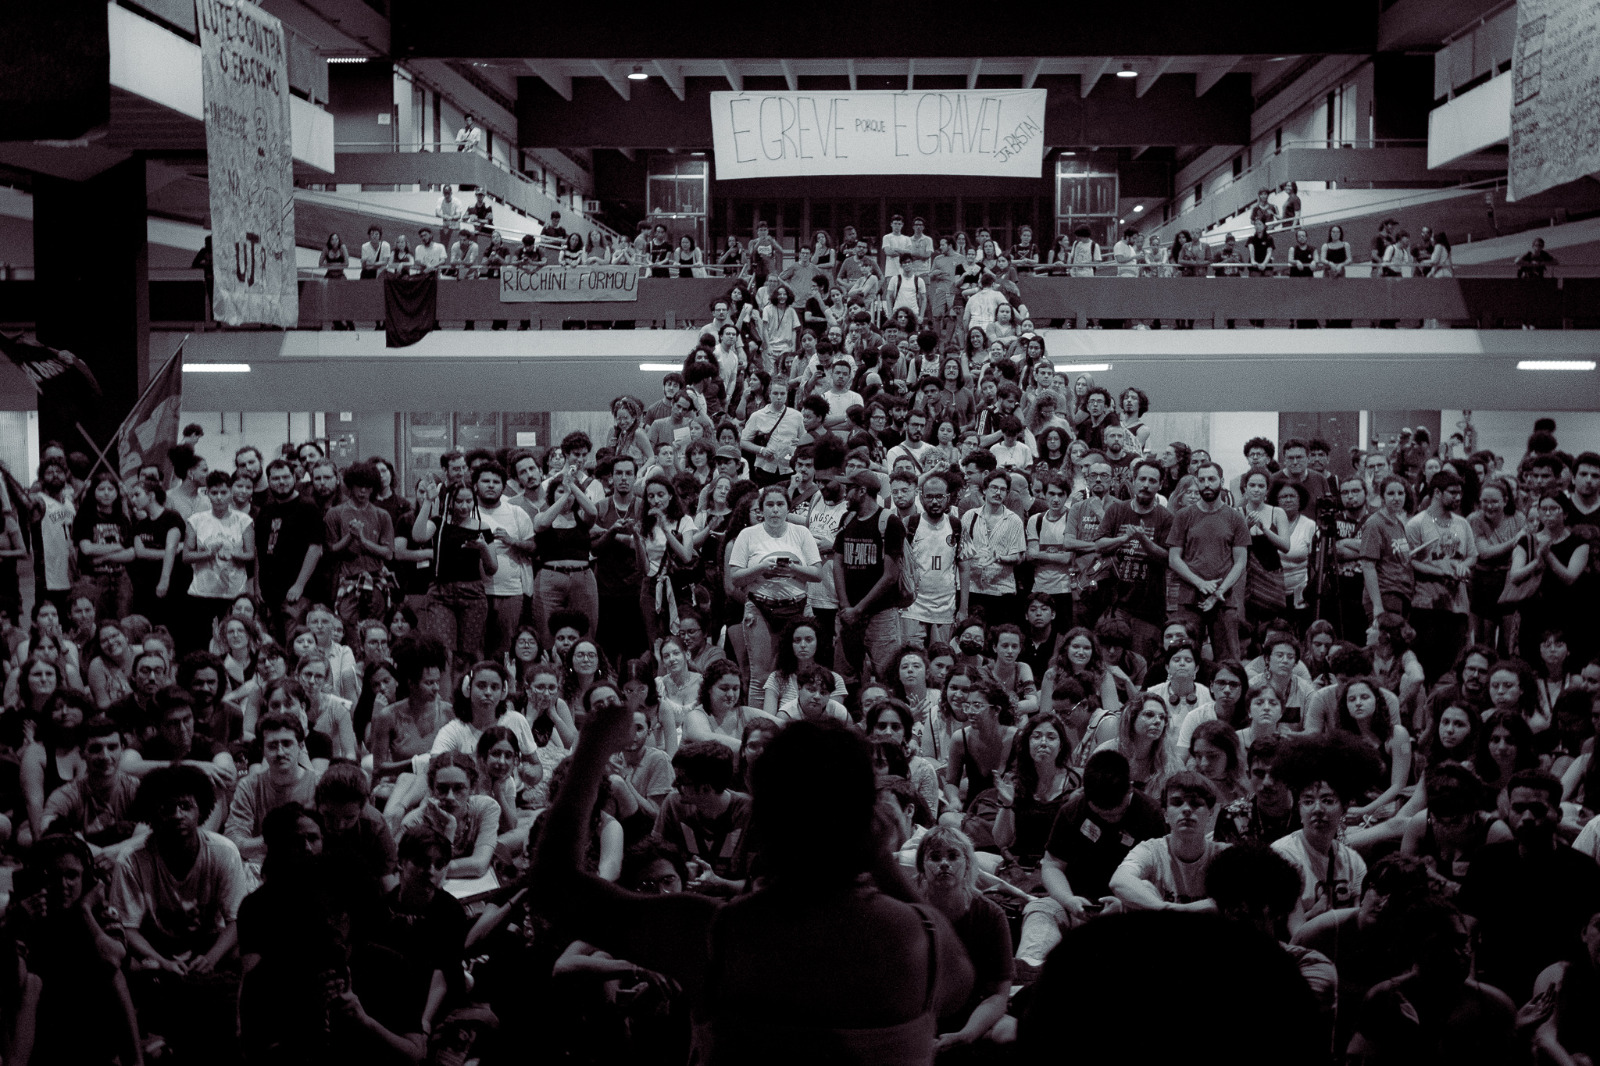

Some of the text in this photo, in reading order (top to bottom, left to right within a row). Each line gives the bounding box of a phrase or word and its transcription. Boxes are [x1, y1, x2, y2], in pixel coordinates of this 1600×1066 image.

[219, 46, 229, 74] O
[730, 91, 757, 163] É
[759, 96, 849, 160] GREVE
[855, 117, 886, 133] PORQUE
[916, 93, 1002, 155] GRAVE!
[1003, 115, 1043, 154] BASTA!
[578, 271, 637, 292] FORMOU
[931, 555, 942, 571] 10
